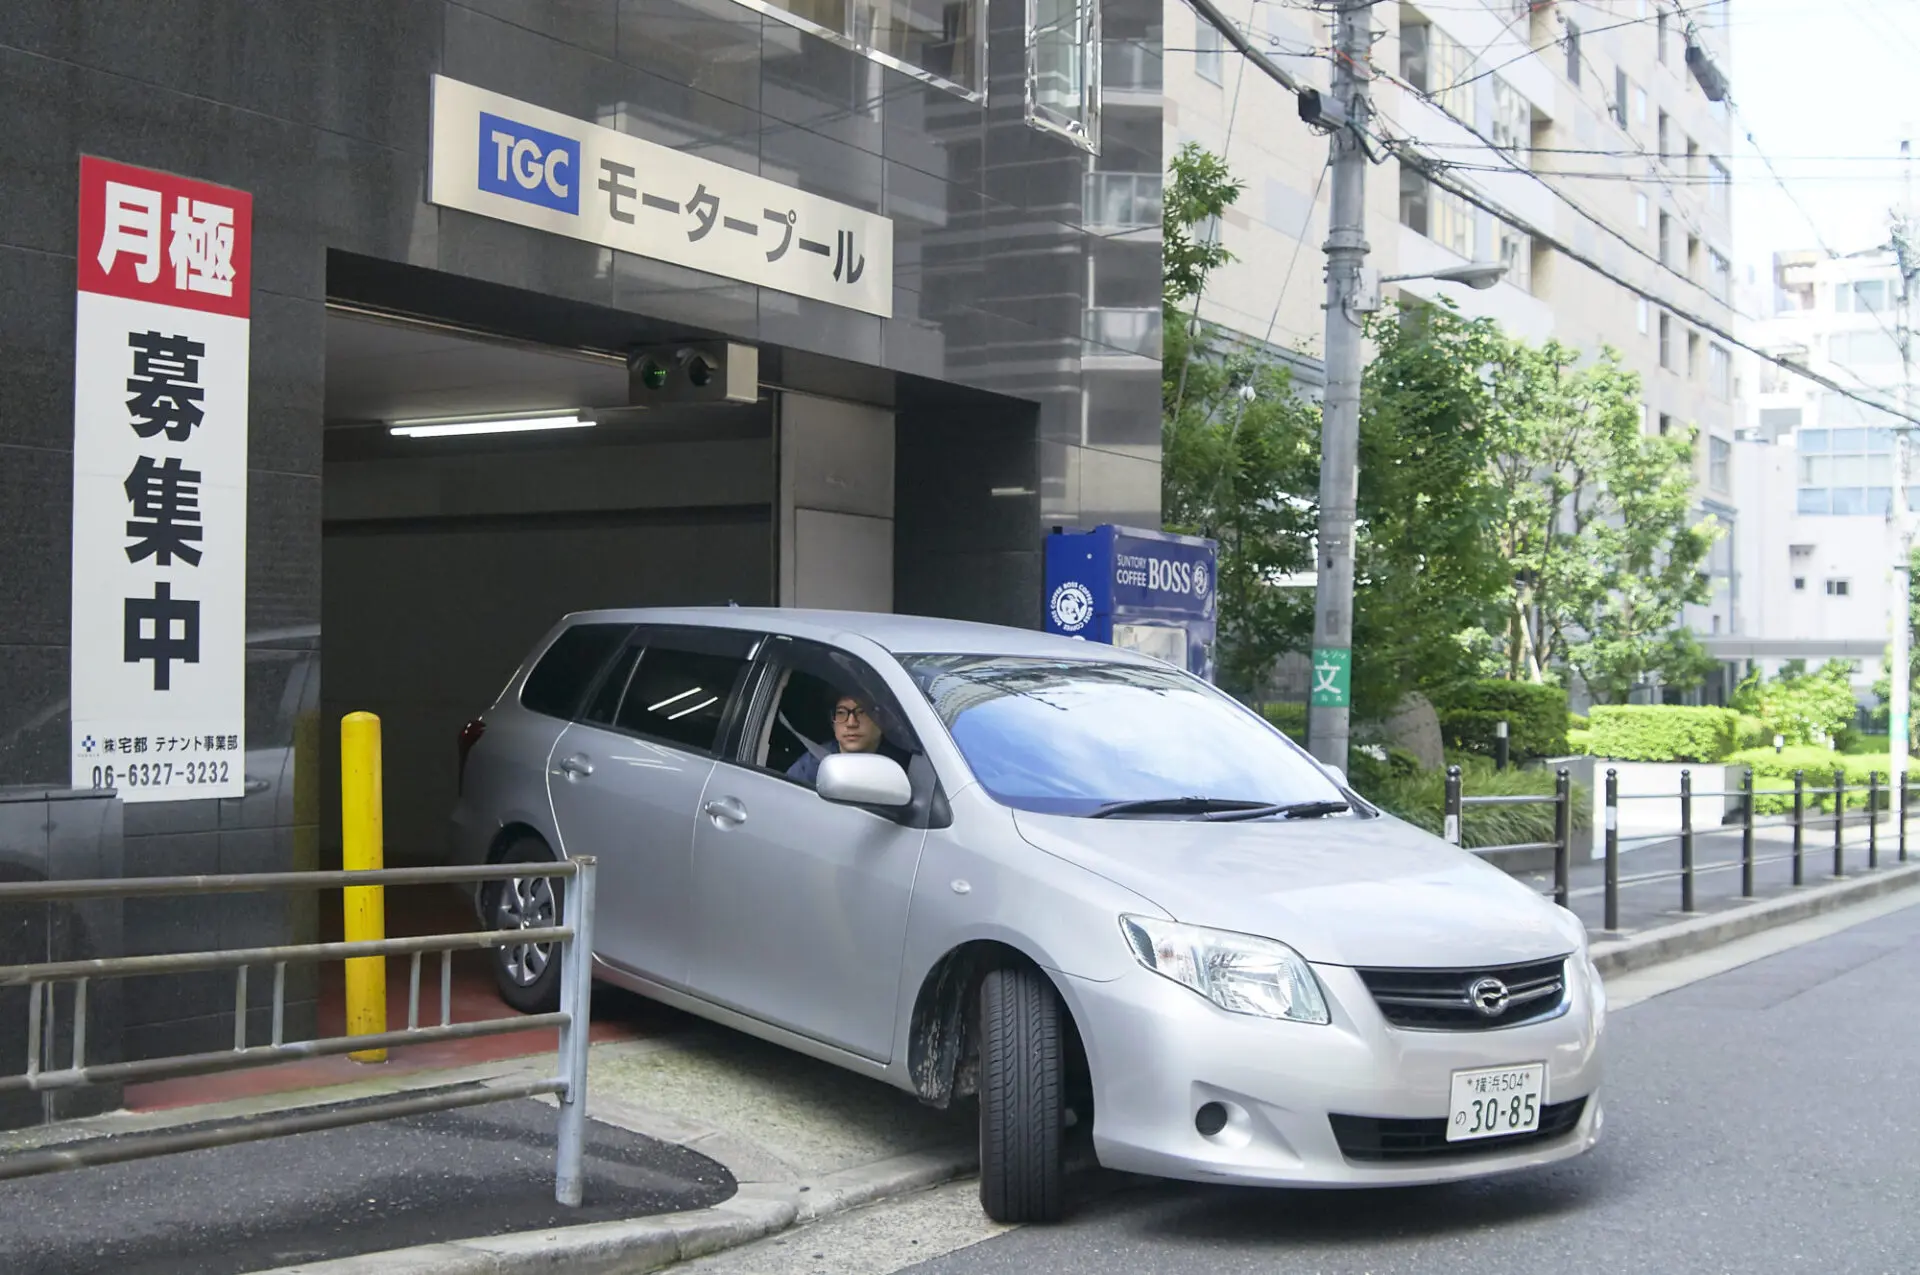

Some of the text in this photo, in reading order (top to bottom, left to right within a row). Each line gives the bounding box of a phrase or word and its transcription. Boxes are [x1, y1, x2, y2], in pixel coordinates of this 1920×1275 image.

[491, 130, 569, 198] TGC
[97, 180, 236, 297] 月極
[598, 157, 865, 284] モータープール
[123, 330, 206, 691] 募集中
[1116, 569, 1147, 588] COFFEE
[1117, 553, 1147, 569] SUNTORY
[1148, 557, 1191, 595] BOSS
[1313, 660, 1341, 693] 文
[155, 735, 238, 752] テナント事業部
[92, 760, 229, 789] 06-6327-3232
[1455, 1093, 1537, 1133] の 30-85
